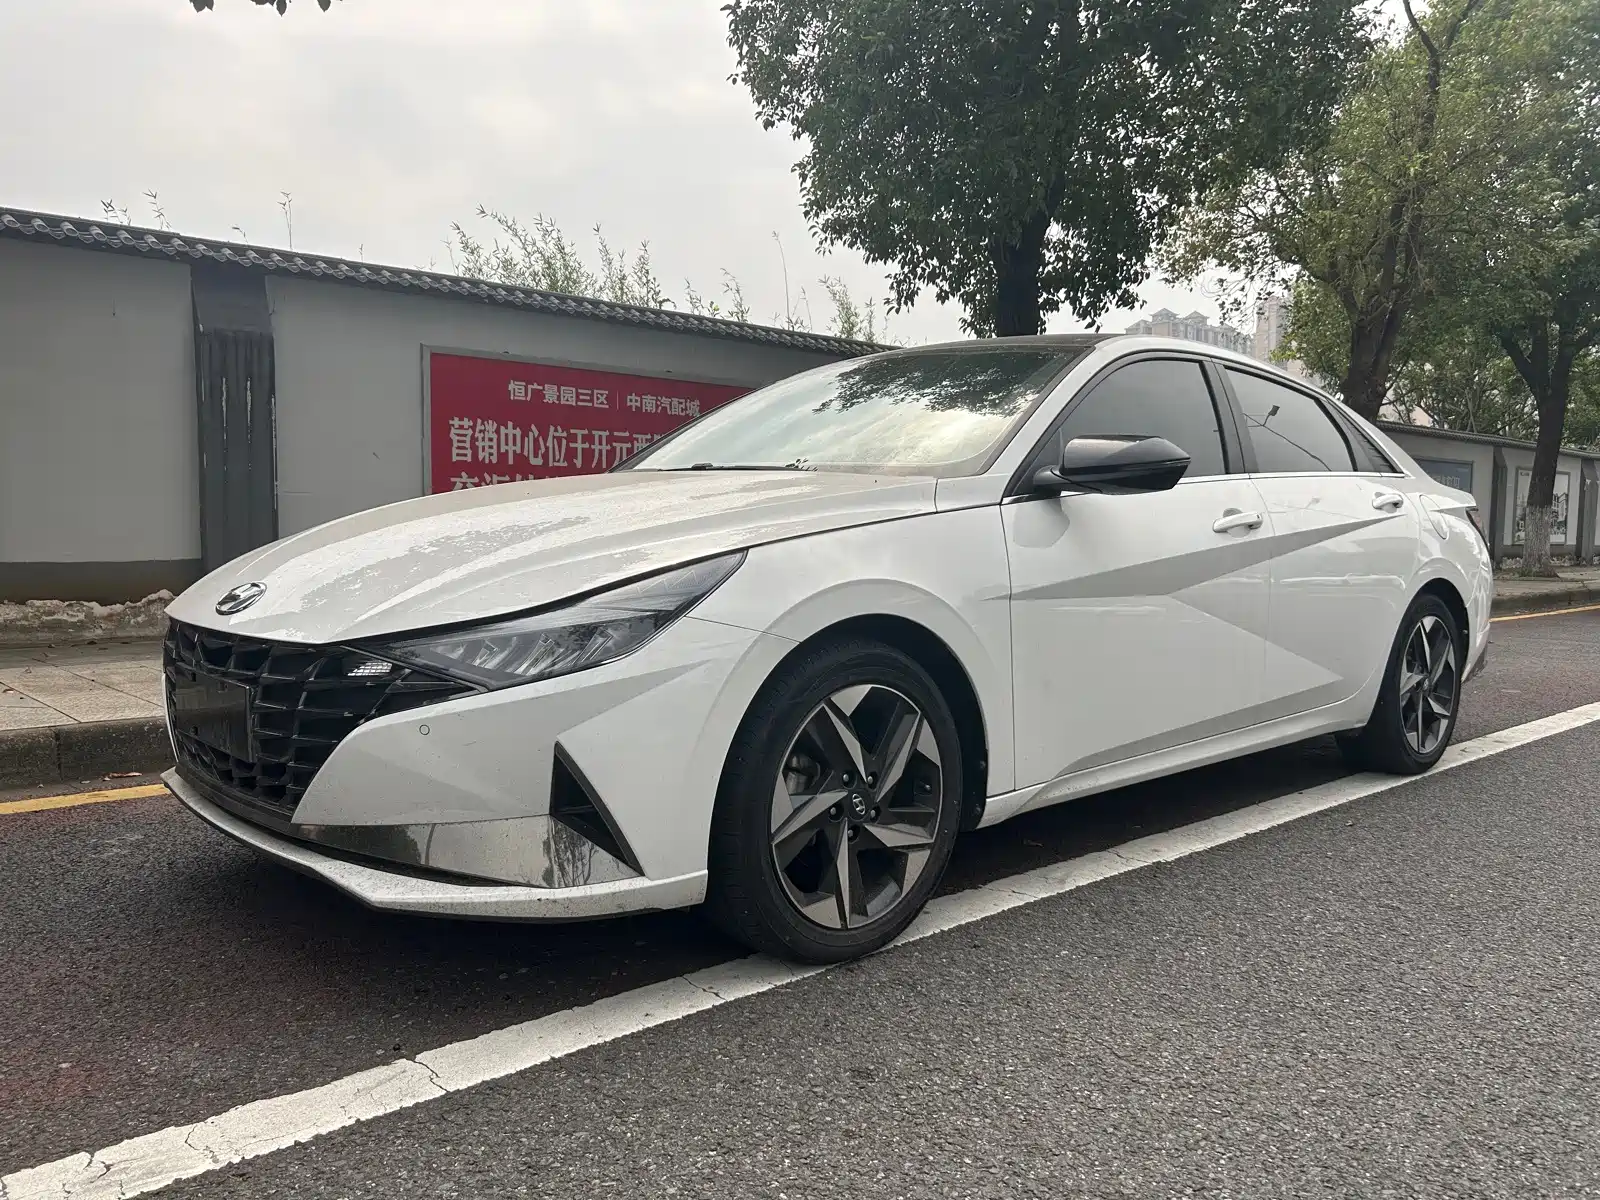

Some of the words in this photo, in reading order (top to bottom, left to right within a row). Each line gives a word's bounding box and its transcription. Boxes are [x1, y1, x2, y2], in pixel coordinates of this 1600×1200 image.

[508, 379, 609, 409] 恒广景园三区
[626, 393, 700, 417] 中南汽配城
[449, 416, 664, 468] 营销中心位于开元
